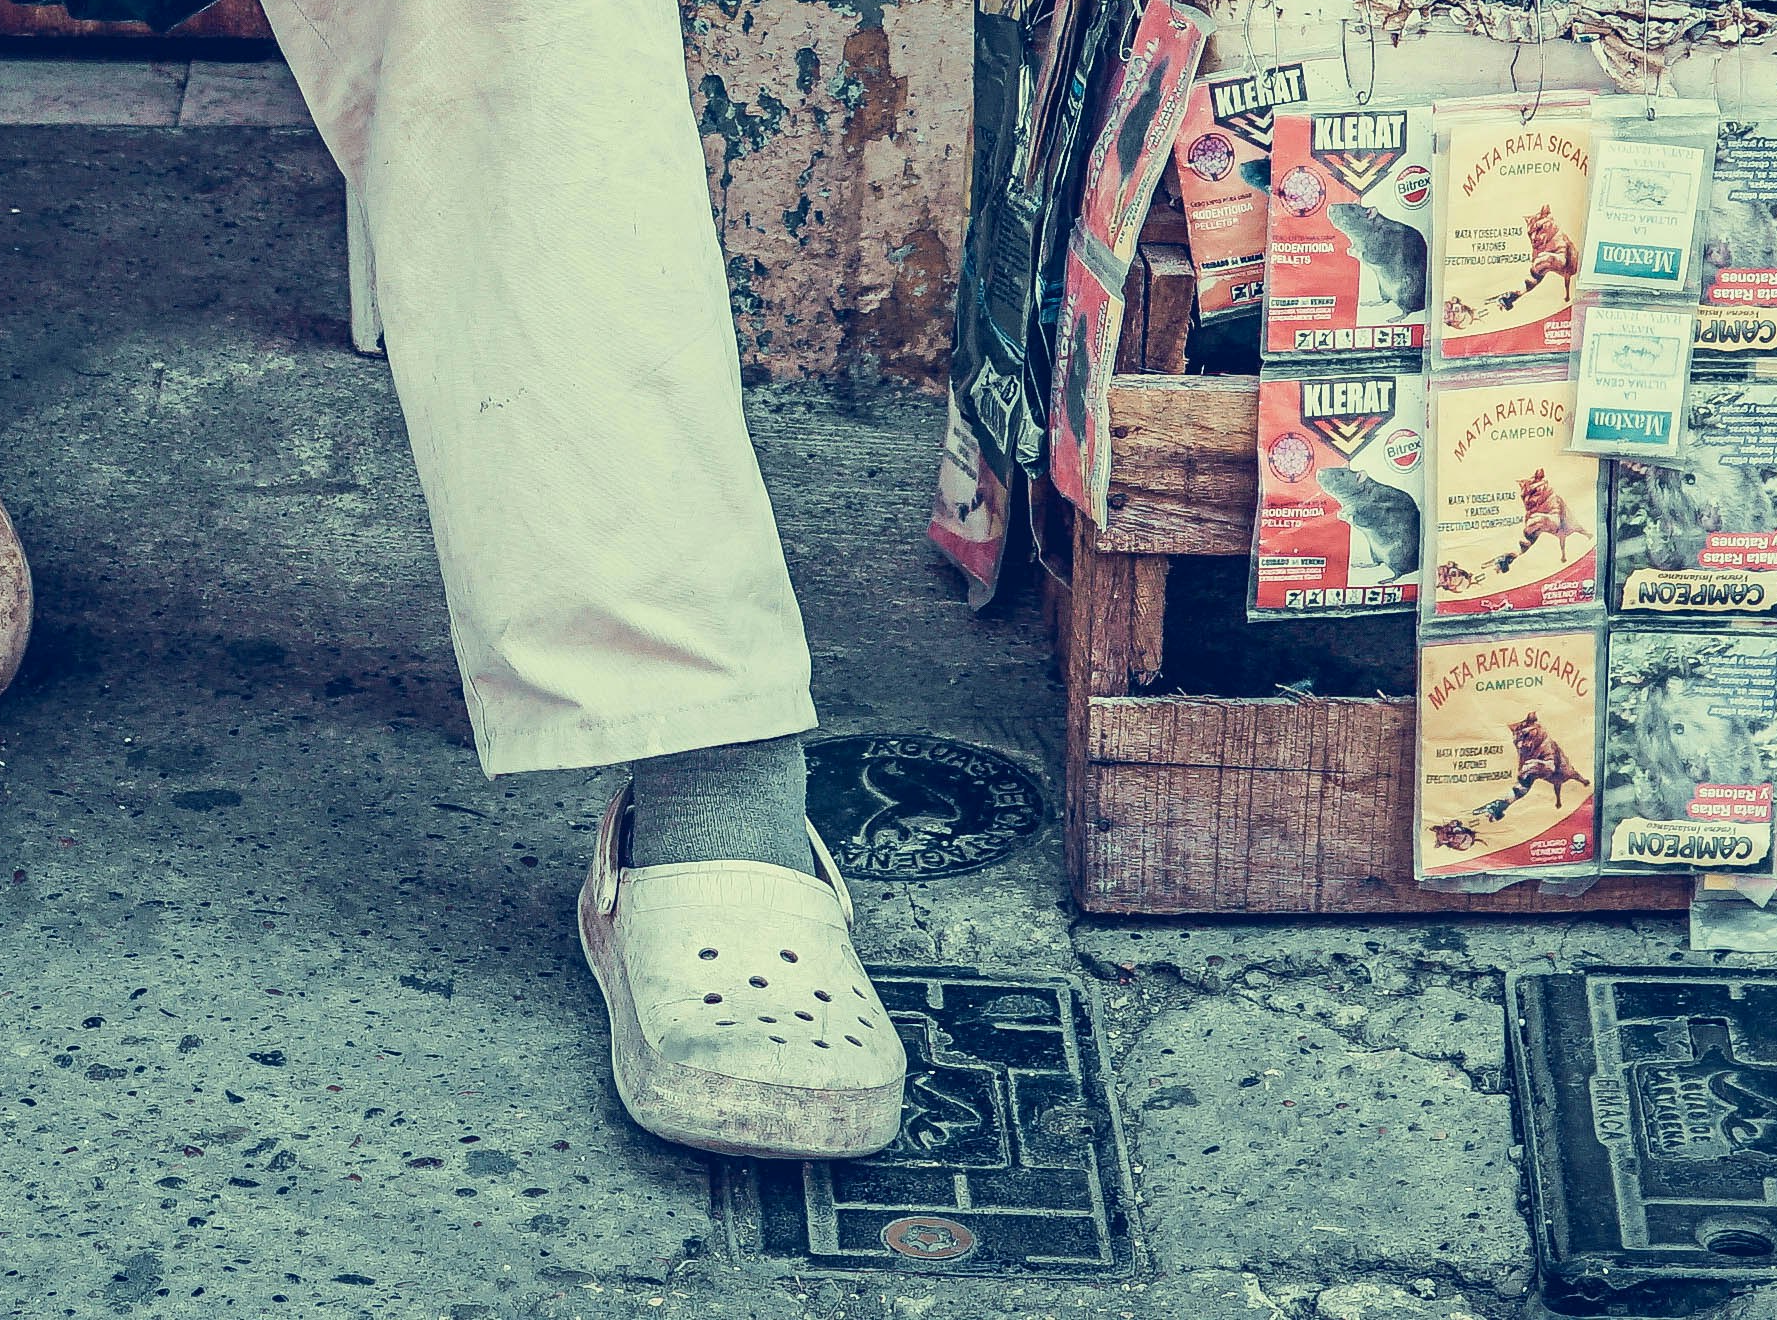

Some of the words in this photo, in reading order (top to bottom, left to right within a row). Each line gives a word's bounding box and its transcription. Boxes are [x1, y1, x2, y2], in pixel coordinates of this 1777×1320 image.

[1213, 68, 1302, 119] KLERAT
[1314, 115, 1406, 151] KLERAT
[1462, 152, 1503, 198] MATA
[1505, 132, 1543, 162] RATA
[1499, 161, 1561, 177] CAMPEON
[1397, 174, 1432, 196] Bitrex
[1602, 244, 1676, 275] Maxton
[1713, 287, 1753, 300] Ratas
[1695, 319, 1777, 345] CAMP
[1305, 380, 1394, 417] KLERAT
[1454, 415, 1493, 463] MATA
[1496, 398, 1535, 422] RATA
[1490, 426, 1555, 442] CAMPEON
[1594, 409, 1667, 438] Maxton
[1387, 439, 1422, 459] Bitrex
[1711, 535, 1770, 549] Ratones
[1702, 550, 1743, 564] Ratas
[1638, 581, 1765, 606] CAMPEON
[1429, 666, 1474, 711] MATA
[1476, 647, 1521, 678] RATA
[1475, 675, 1544, 693] CAMPEON
[1699, 786, 1757, 801] Ratones
[1691, 802, 1729, 816] Ratas
[1731, 803, 1769, 818] Mata
[1627, 830, 1754, 860] CAMPEON
